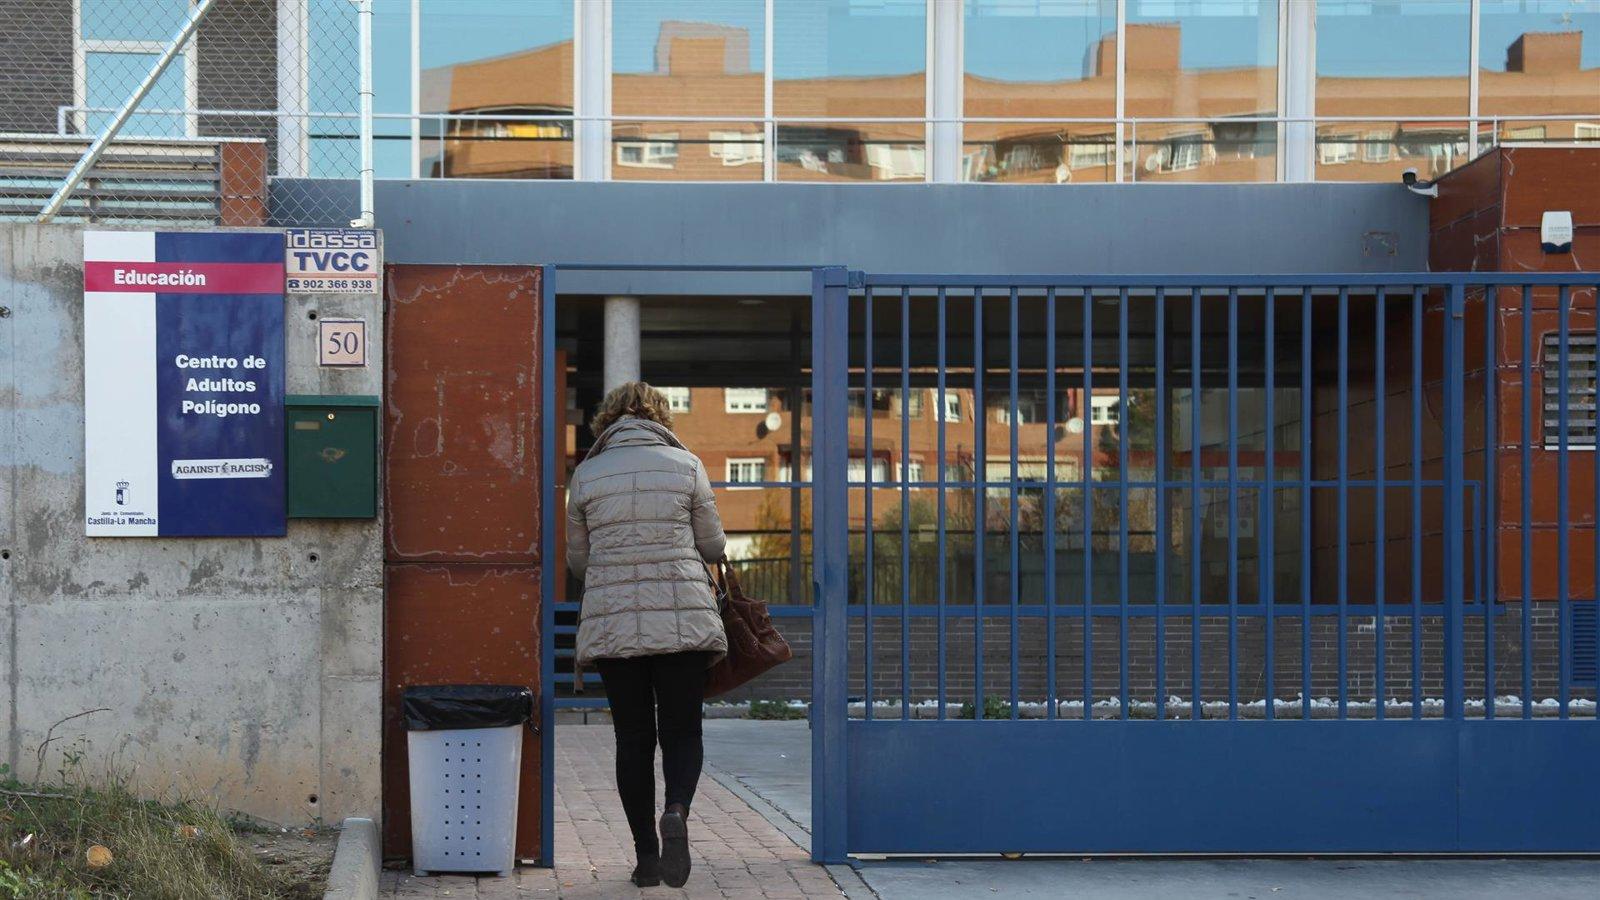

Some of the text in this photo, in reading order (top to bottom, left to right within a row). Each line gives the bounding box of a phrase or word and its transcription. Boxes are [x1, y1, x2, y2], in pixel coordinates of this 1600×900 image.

[287, 230, 375, 249] idassa
[294, 251, 369, 272] TVCC
[113, 269, 206, 286] Educación
[303, 280, 372, 289] 902 366 938
[328, 331, 359, 355] 50
[175, 354, 266, 370] Centro de
[186, 378, 256, 392] Adultos
[182, 399, 261, 418] Polígono
[176, 464, 270, 474] AGAINST RACISM
[87, 517, 156, 525] Castilla-La Mancha
